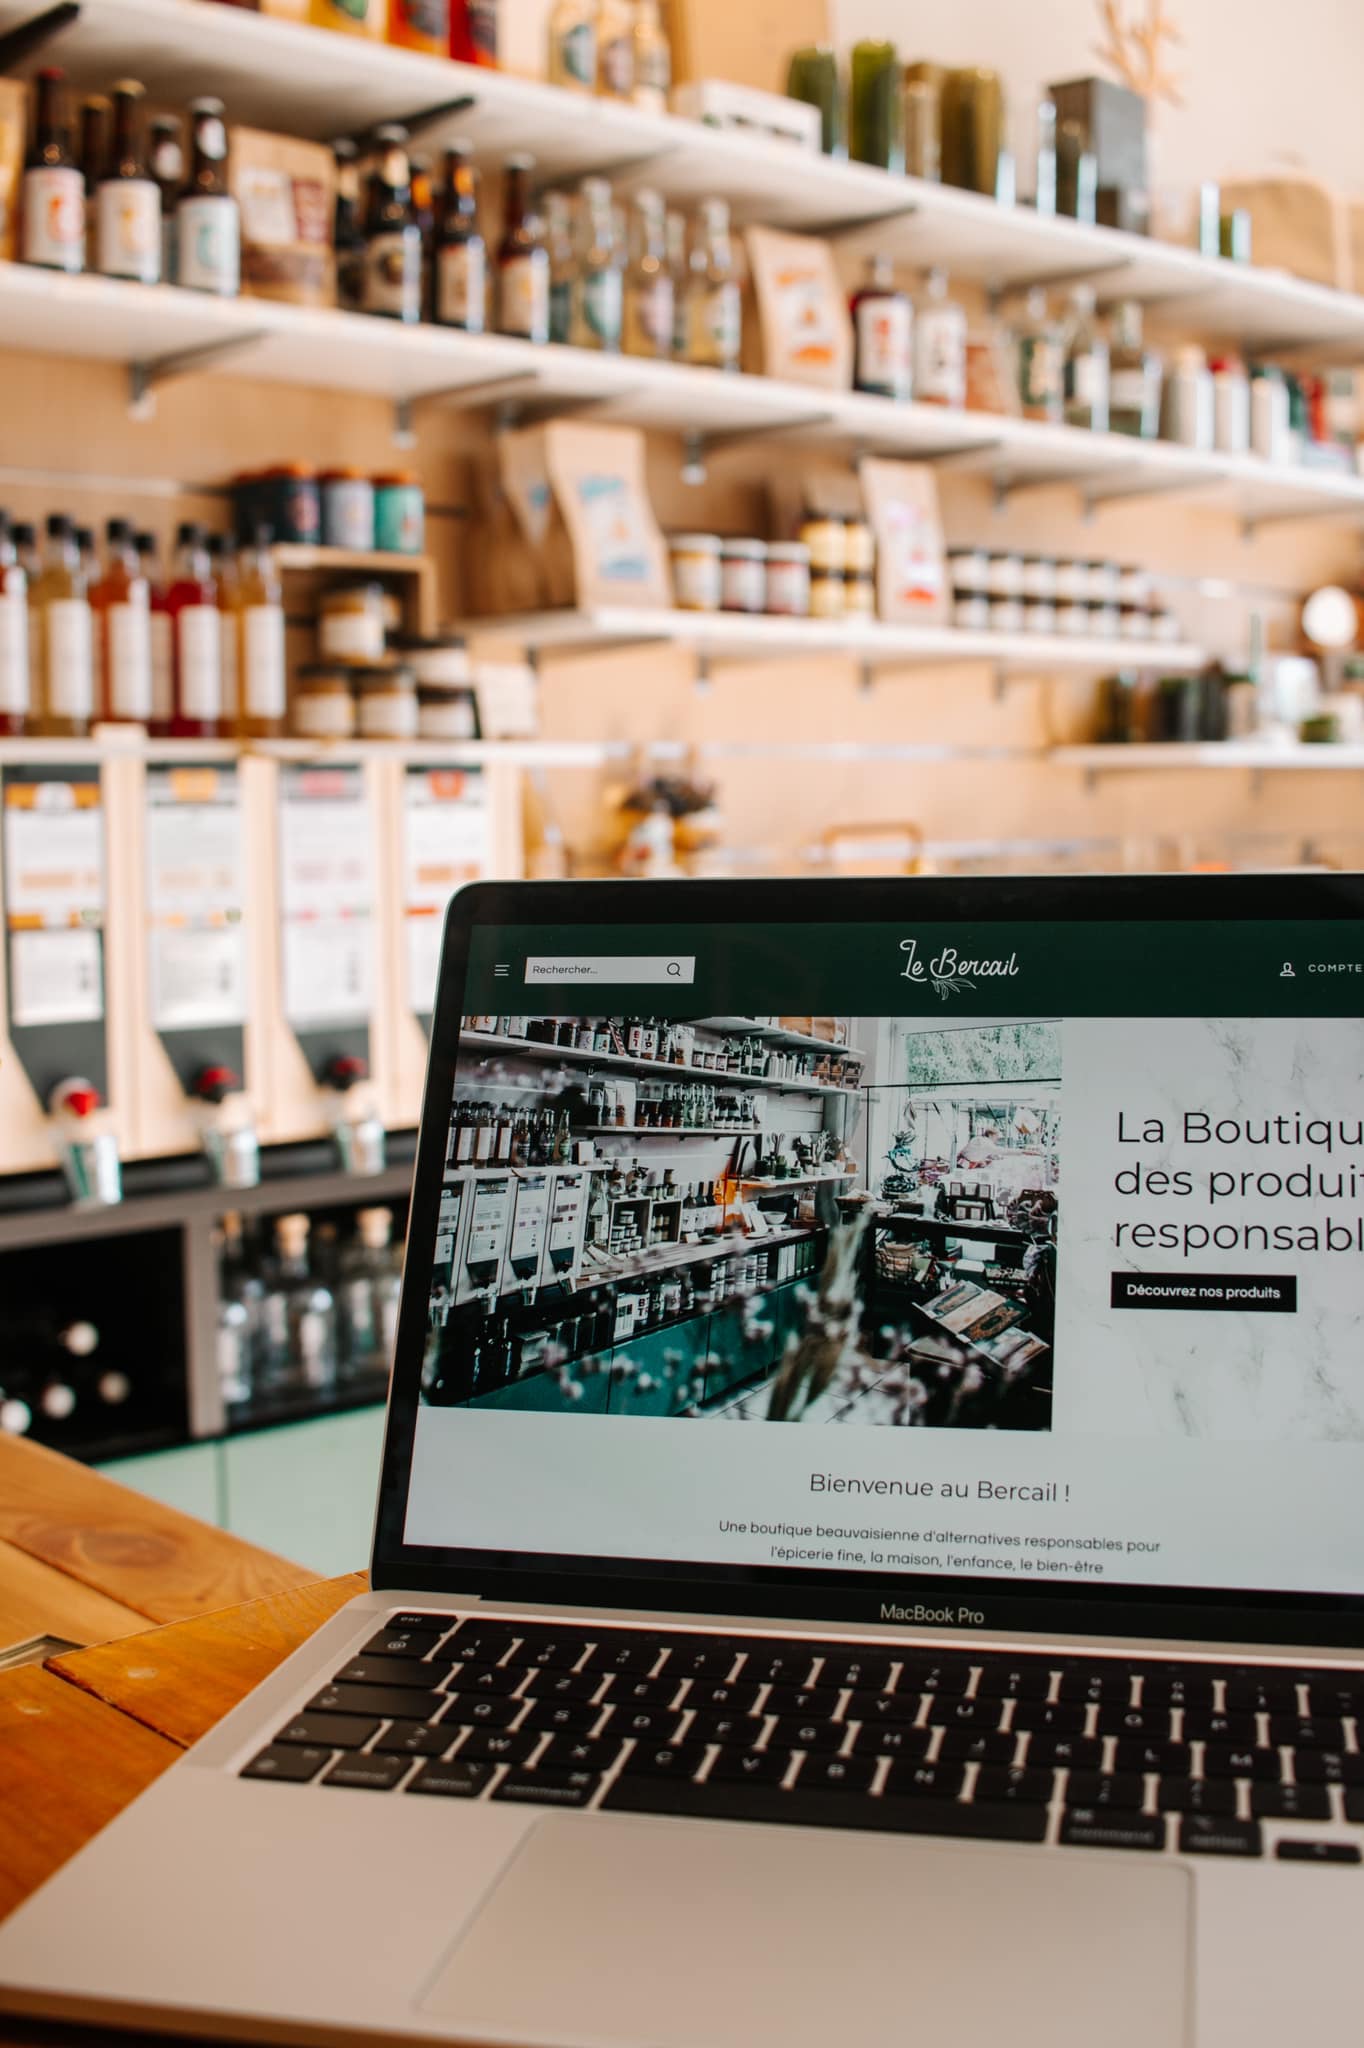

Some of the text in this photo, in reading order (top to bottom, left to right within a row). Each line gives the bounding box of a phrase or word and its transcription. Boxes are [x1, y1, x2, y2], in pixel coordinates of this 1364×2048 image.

[900, 939, 1019, 982] Le Bercail
[1307, 963, 1363, 974] COMPTE
[1118, 1111, 1363, 1154] La Boutiqu
[1114, 1161, 1364, 1205] des produi
[1115, 1216, 1364, 1258] responsabl
[1126, 1283, 1281, 1300] Découvrez nos produits
[810, 1473, 934, 1497] Bienvenue
[940, 1483, 969, 1498] au
[977, 1480, 1057, 1502] Bercail
[719, 1520, 1161, 1554] Une boutique beauvaisienne d'alternatives responsables pour
[770, 1545, 1104, 1574] l'épicerie fine, la maison, l'enfance, le bien-être
[880, 1603, 985, 1624] MacBook Pro
